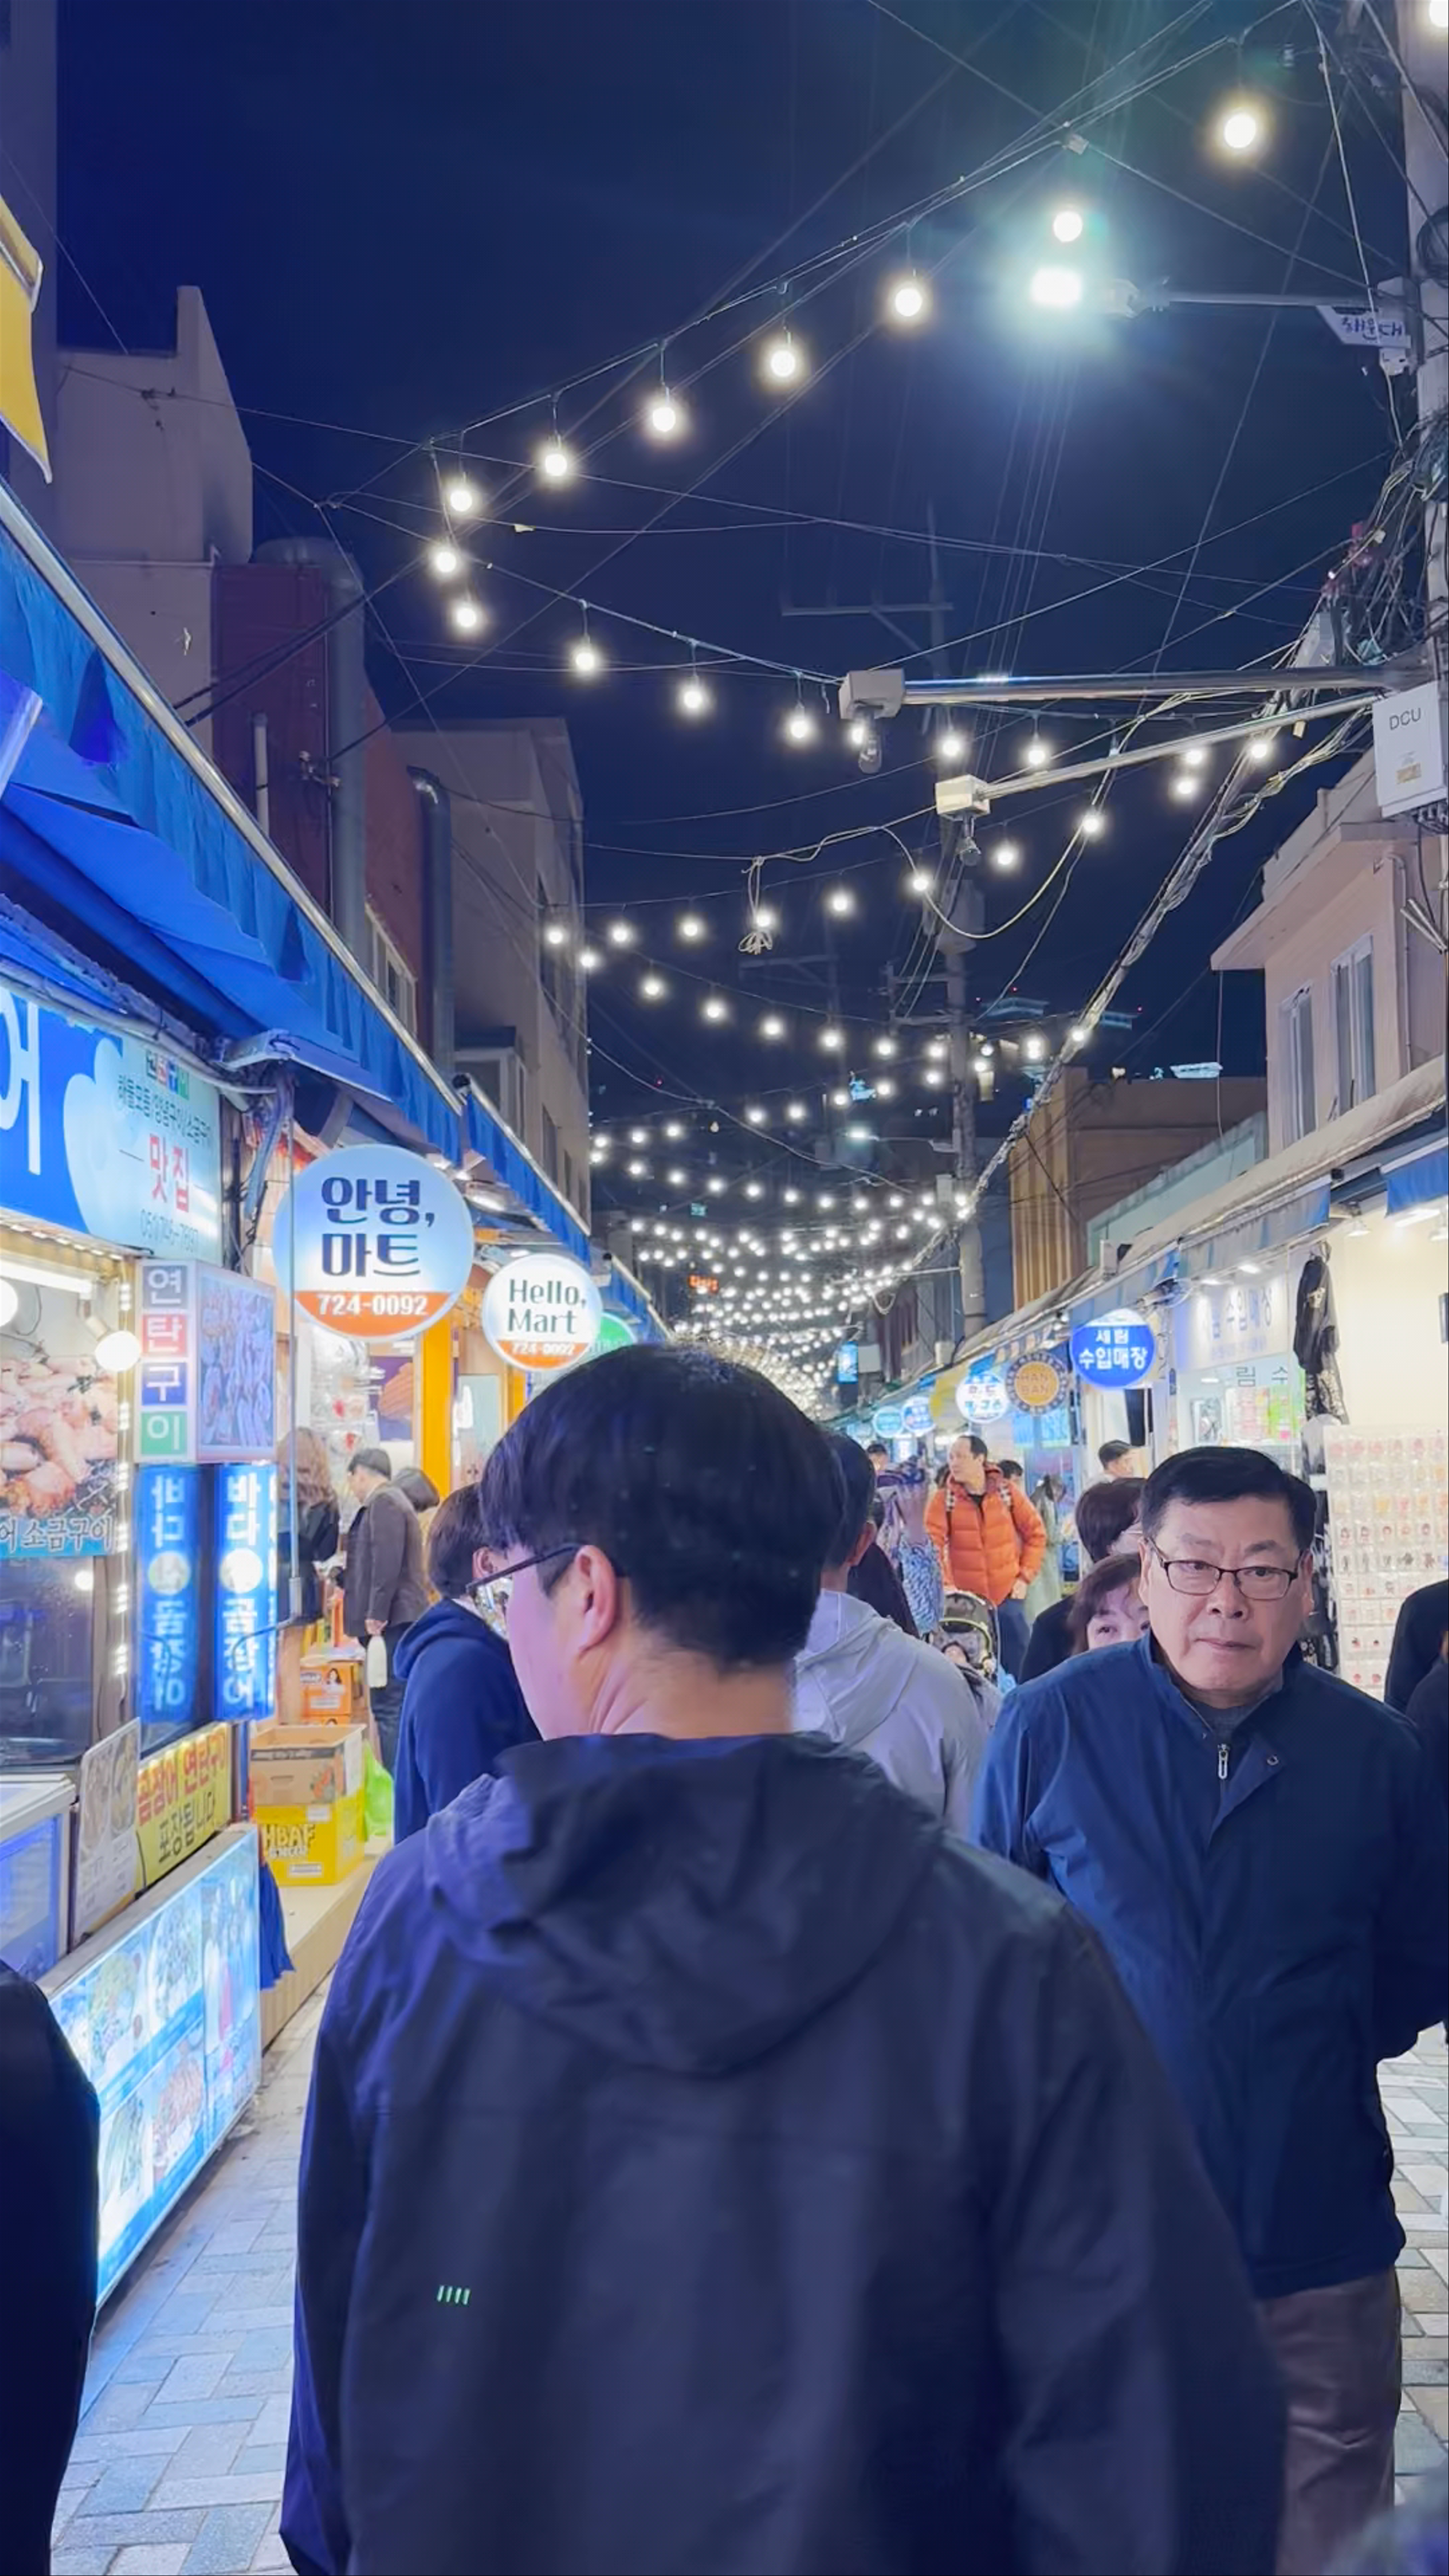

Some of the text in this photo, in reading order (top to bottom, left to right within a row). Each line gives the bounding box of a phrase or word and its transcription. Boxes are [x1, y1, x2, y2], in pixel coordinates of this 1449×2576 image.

[1390, 708, 1421, 731] DCU
[149, 1133, 189, 1213] 맛집
[321, 1177, 435, 1227] 안녕,
[322, 1233, 420, 1277] 마트
[318, 1294, 428, 1315] 724-0092
[509, 1279, 586, 1309] Hello,
[508, 1308, 578, 1335] Mart
[146, 1269, 183, 1451] 연탄구이
[1079, 1346, 1149, 1370] 수입매장
[227, 1472, 261, 1546] 바다
[262, 1824, 316, 1854] HBAF
